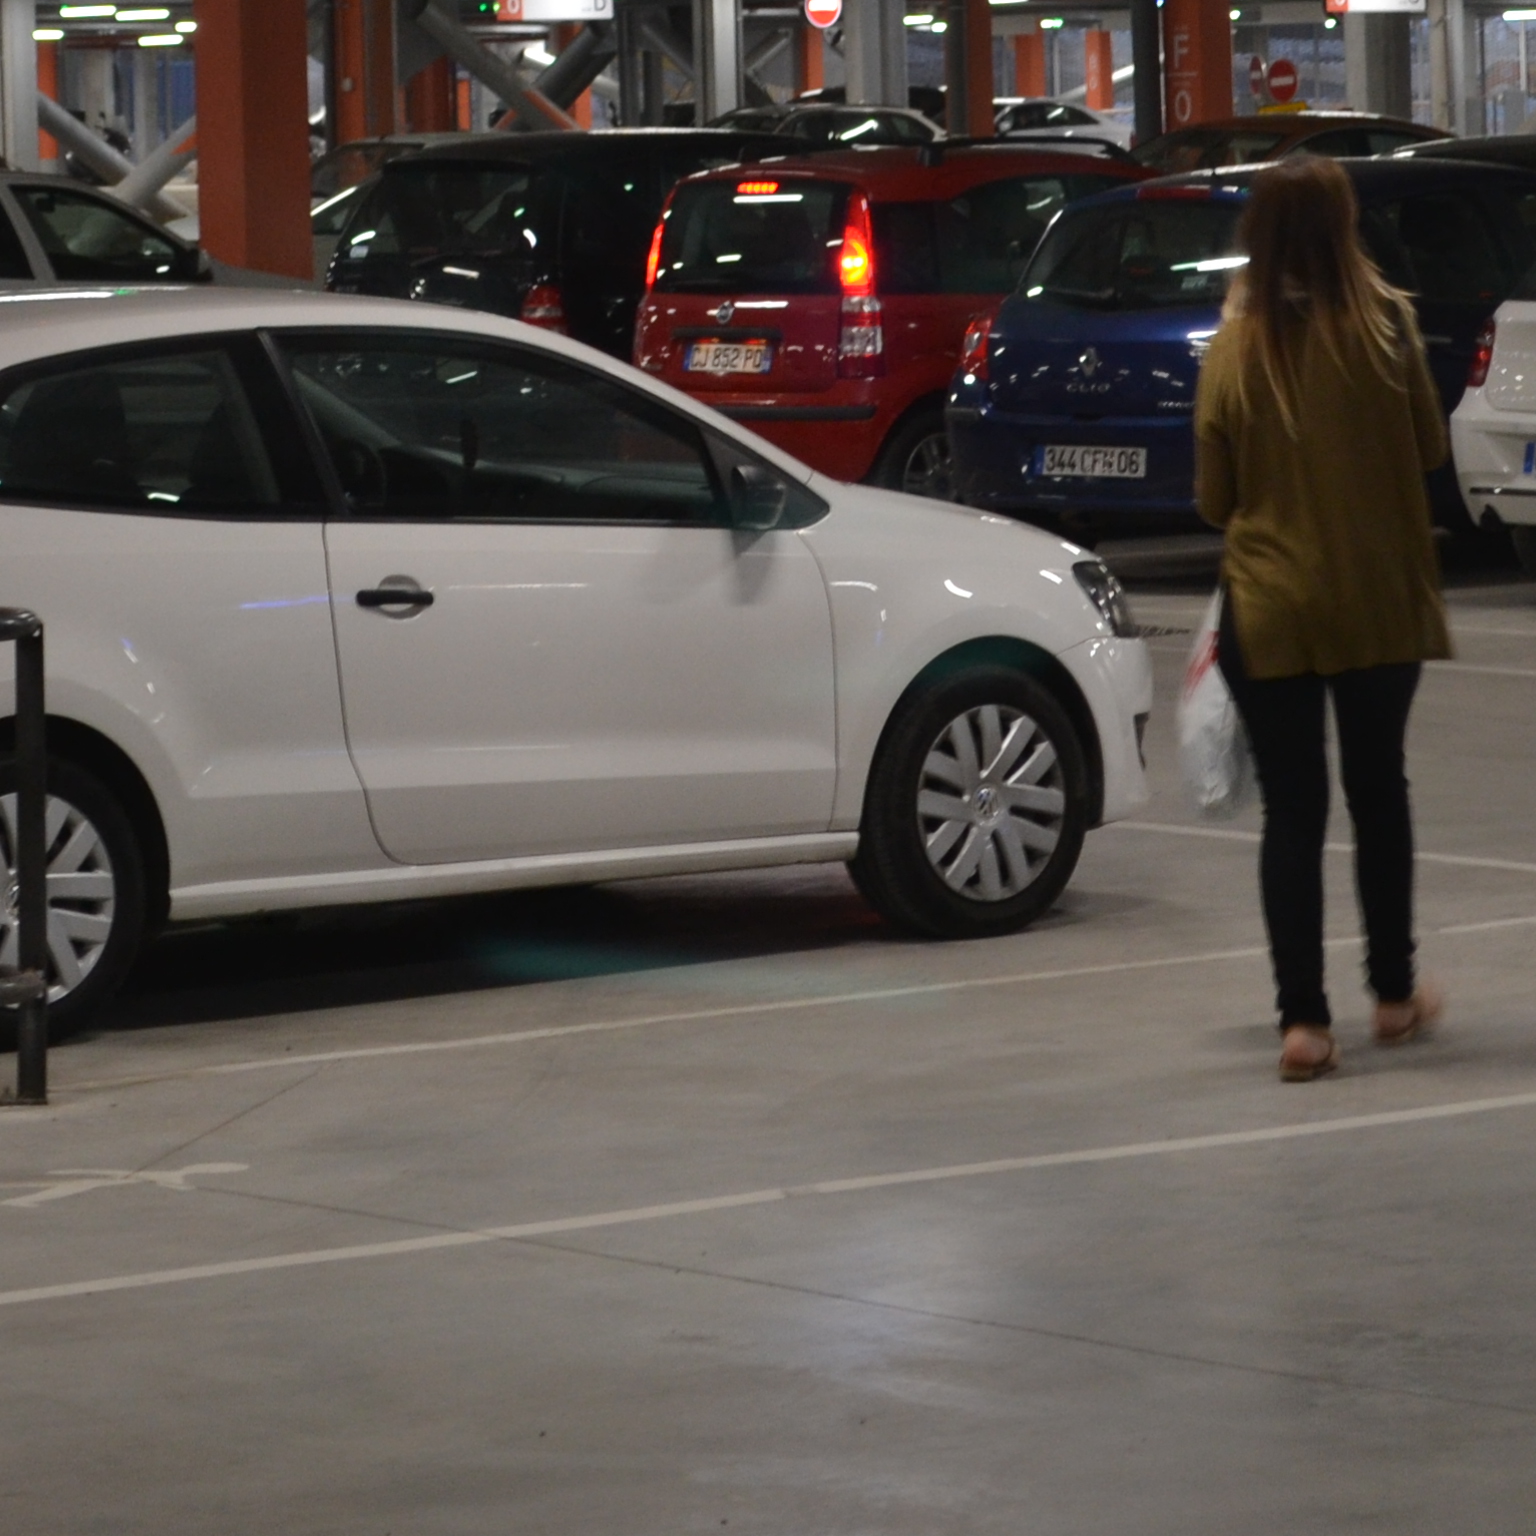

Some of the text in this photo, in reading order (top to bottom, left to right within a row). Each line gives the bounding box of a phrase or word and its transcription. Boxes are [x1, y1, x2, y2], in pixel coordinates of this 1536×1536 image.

[1173, 33, 1190, 70] F
[712, 347, 740, 368] 852
[1046, 448, 1076, 473] 344
[1117, 450, 1140, 474] 06
